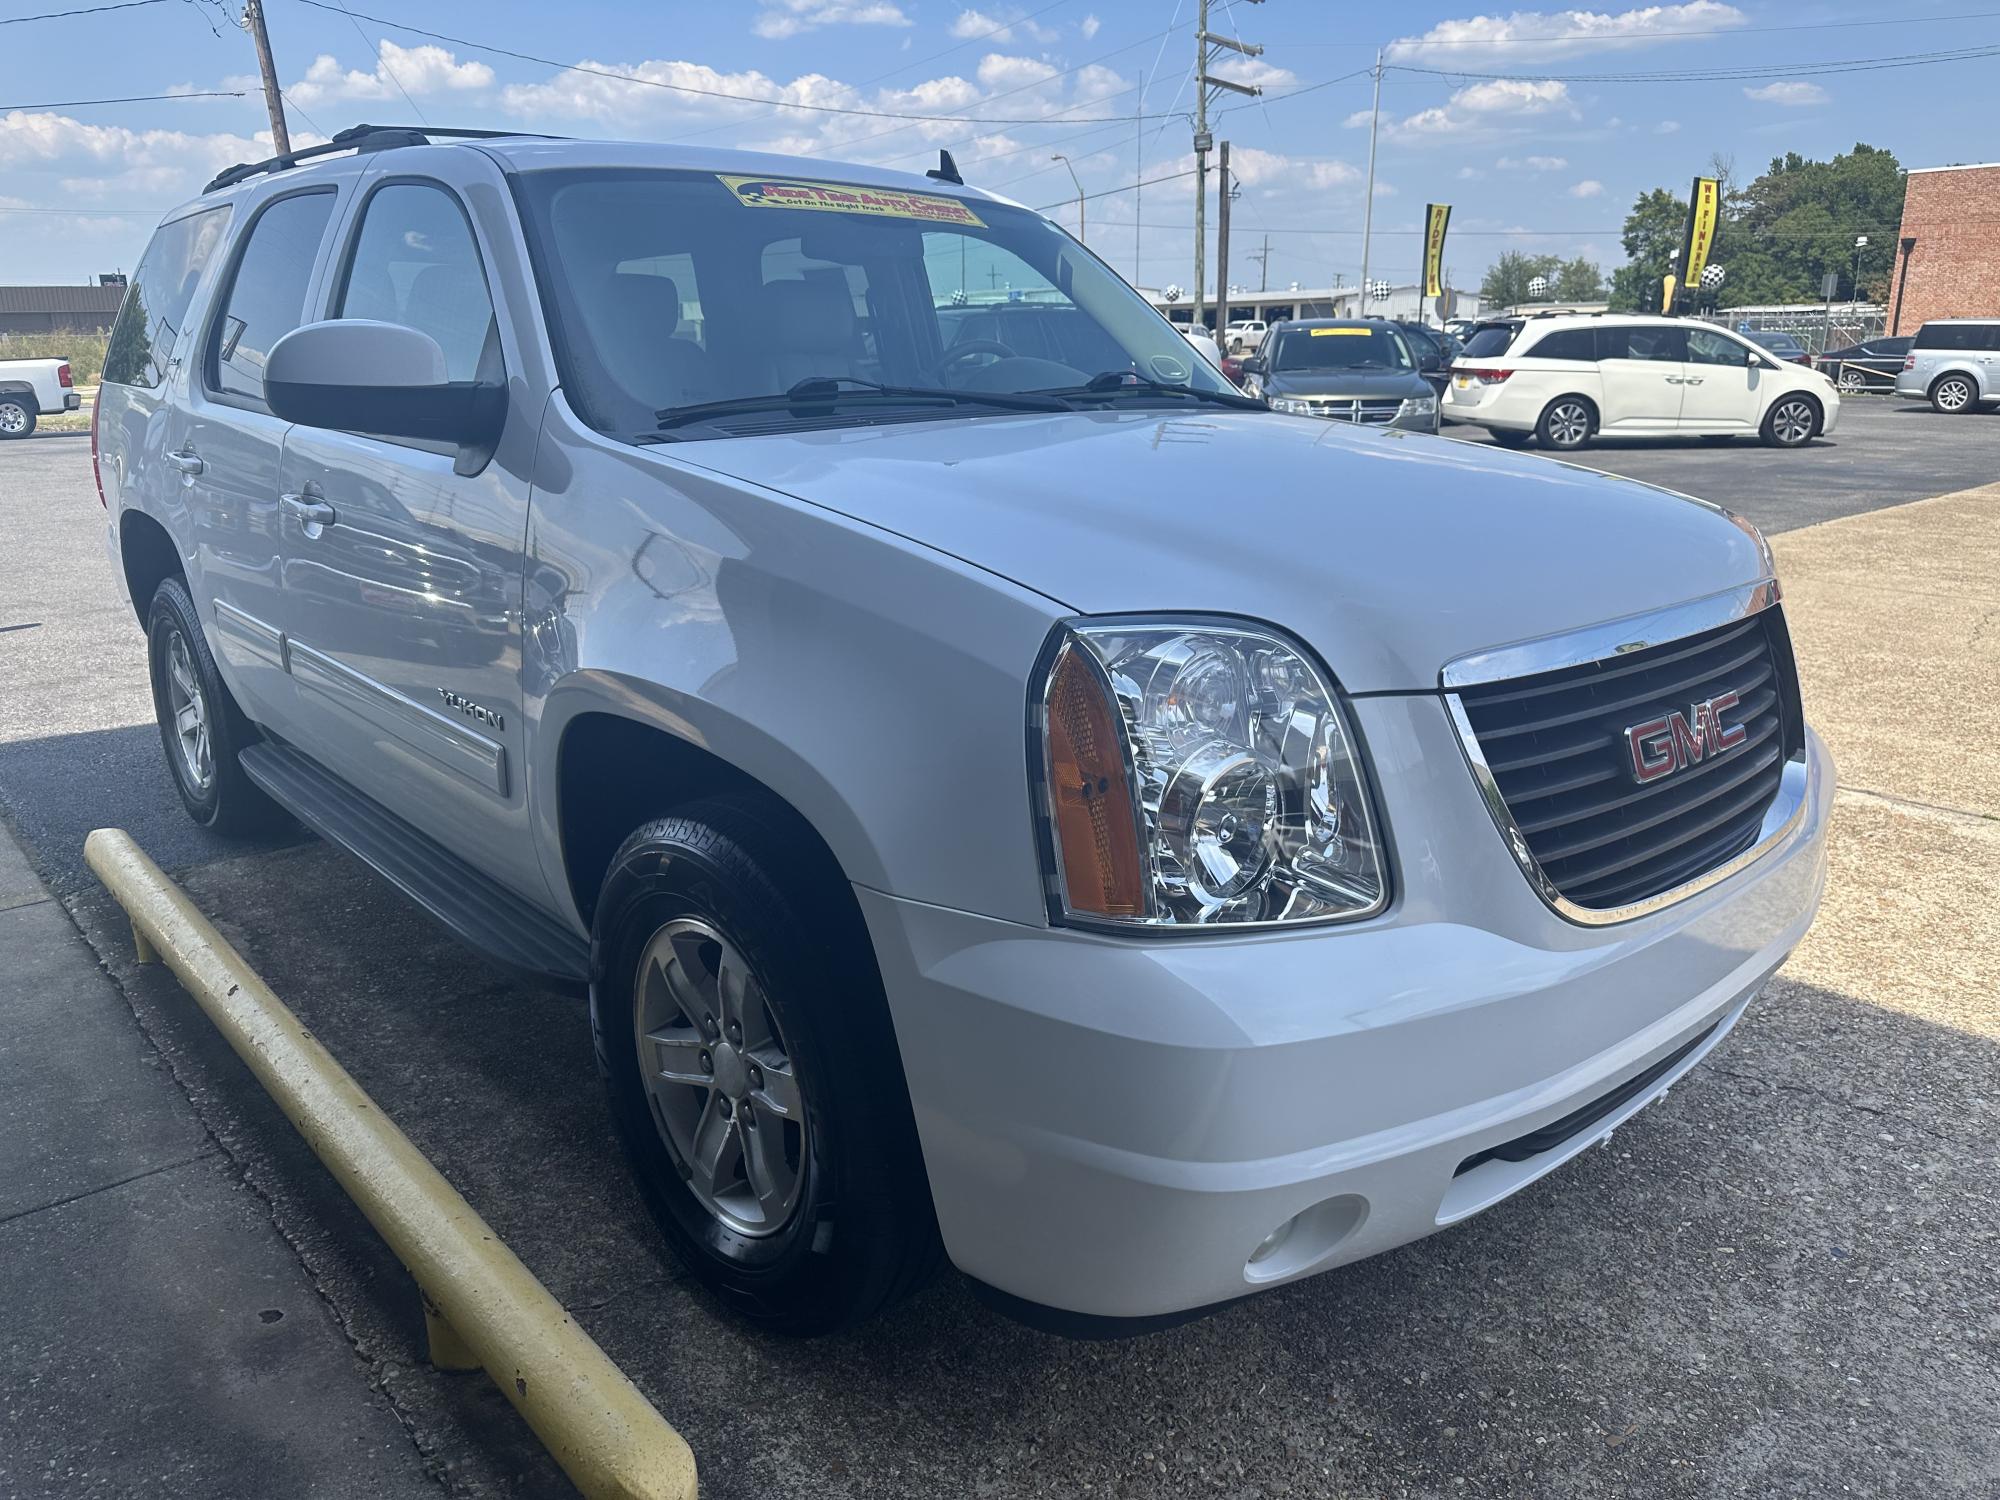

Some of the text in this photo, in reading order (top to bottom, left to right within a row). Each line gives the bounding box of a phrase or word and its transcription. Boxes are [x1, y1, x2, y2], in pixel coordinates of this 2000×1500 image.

[786, 198, 801, 206] Get
[819, 200, 835, 208] The
[836, 202, 859, 210] Right
[862, 203, 885, 212] Track
[860, 193, 909, 209] AUTO
[1428, 208, 1443, 293] RIDE TIME
[1691, 184, 1712, 283] WE FINANCE
[437, 687, 505, 731] YUKON
[1624, 690, 1747, 784] GMC
